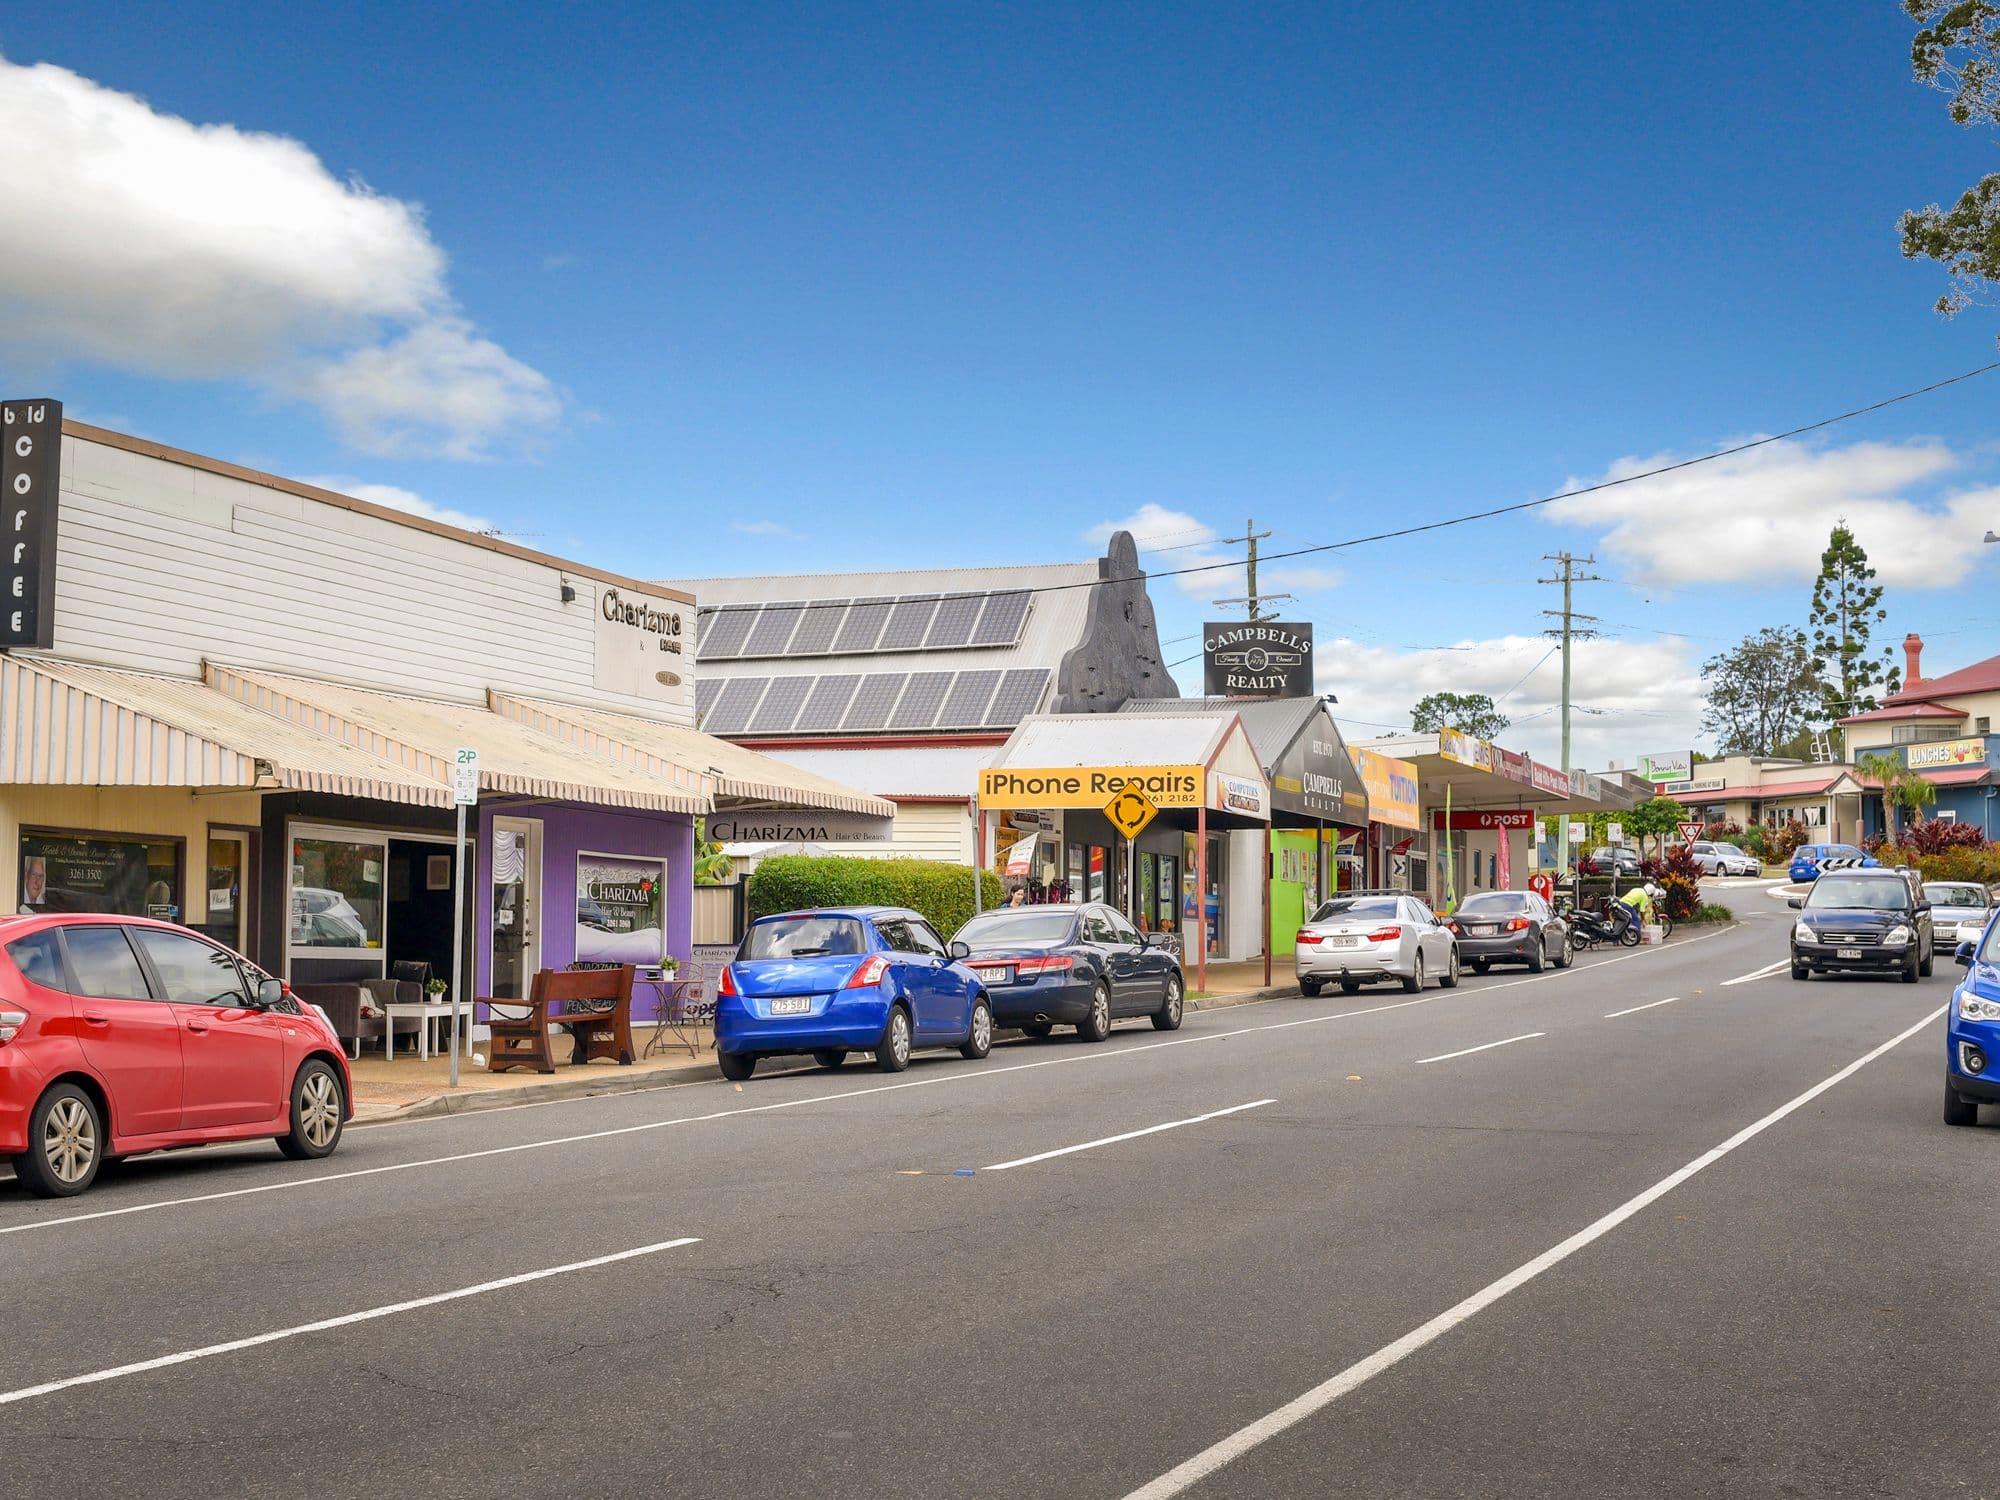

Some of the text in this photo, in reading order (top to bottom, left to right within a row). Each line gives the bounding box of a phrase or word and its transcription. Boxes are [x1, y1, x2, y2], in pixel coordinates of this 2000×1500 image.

[4, 405, 45, 425] bld
[11, 435, 33, 632] COFFEE
[602, 589, 682, 636] Charizma
[1204, 628, 1312, 653] CAMPBELLS
[1226, 674, 1288, 689] REALTY
[457, 750, 477, 764] 2P
[1911, 746, 1951, 765] LUNCHES
[985, 772, 1197, 797] iPhone Repairs
[1303, 771, 1342, 798] CAMPBELLS
[1168, 794, 1196, 802] 2182
[1304, 796, 1342, 813] REALTY
[1494, 815, 1528, 825] POST
[711, 821, 829, 841] CHARiZMA
[834, 832, 850, 841] Hair
[70, 868, 102, 881] 3261 3500
[588, 881, 649, 903] CHARiZMA
